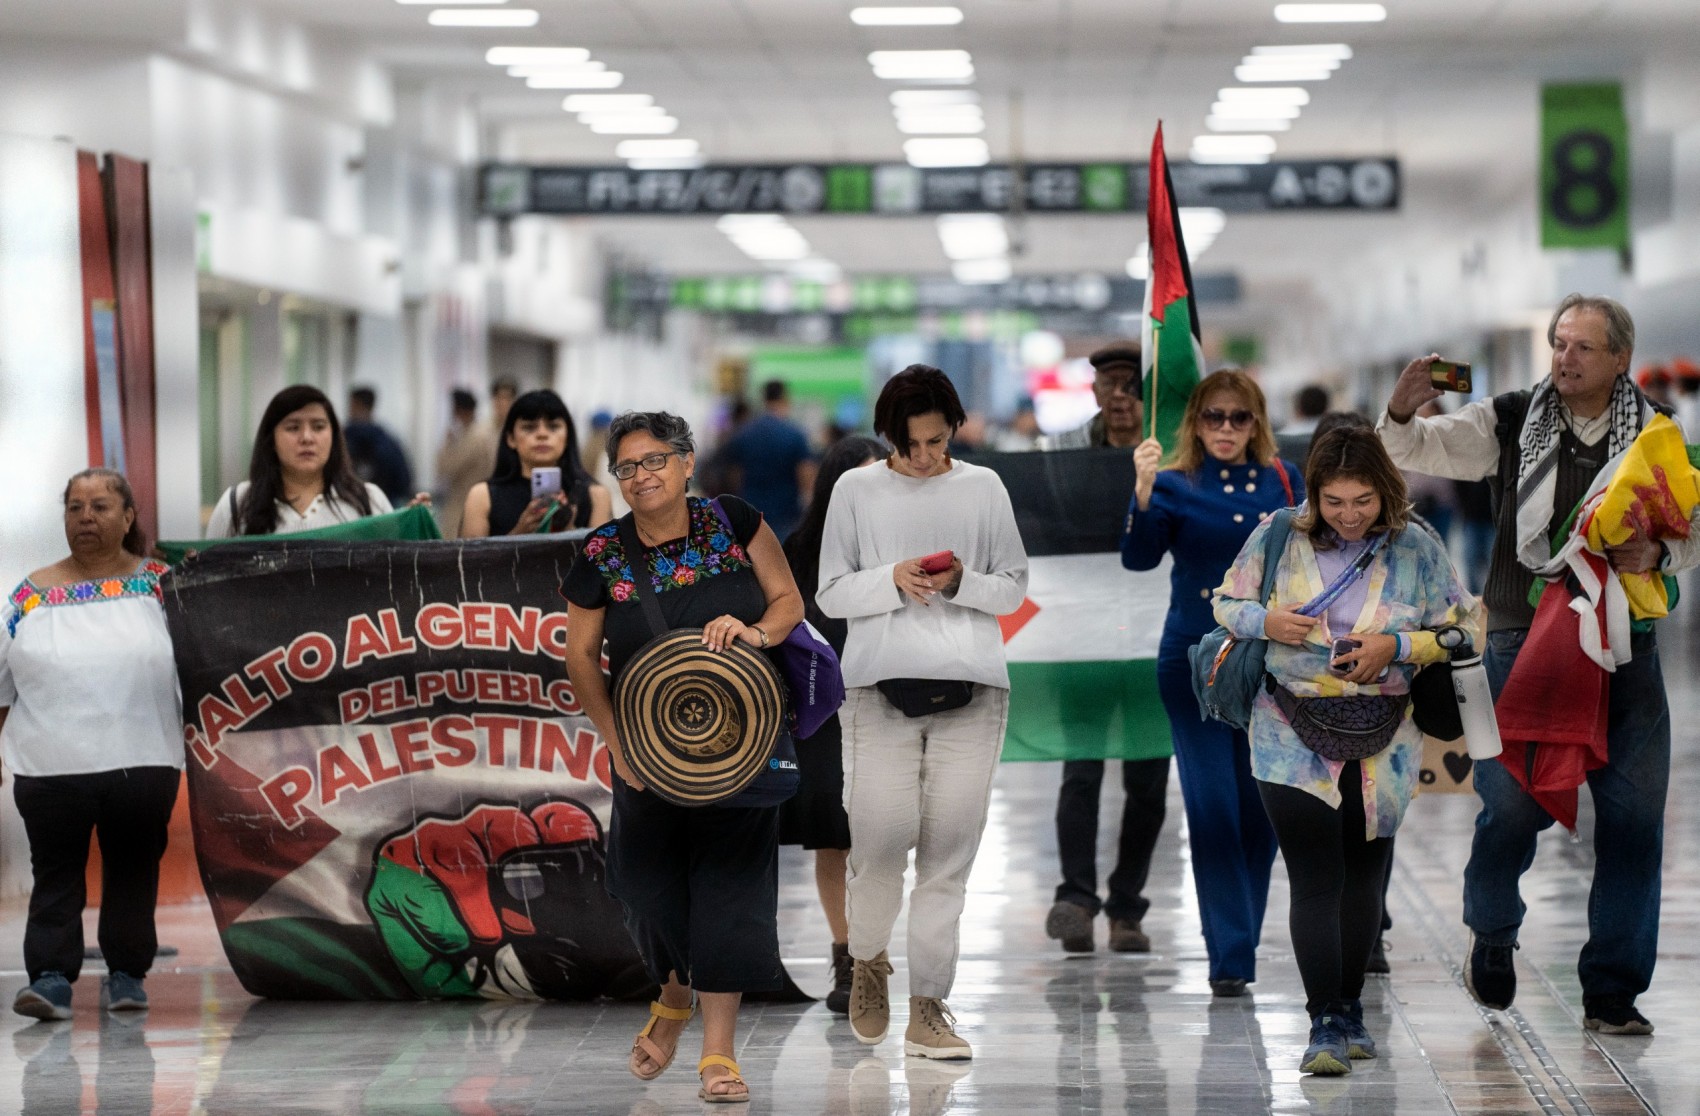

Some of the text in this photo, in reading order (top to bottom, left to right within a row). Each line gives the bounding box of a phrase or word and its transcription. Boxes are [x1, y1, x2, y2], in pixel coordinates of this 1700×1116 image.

[1551, 130, 1618, 229] 8
[184, 602, 568, 769] ¡ALTO AL GENO
[338, 668, 585, 724] DEL PUEBLO
[809, 668, 817, 681] POR
